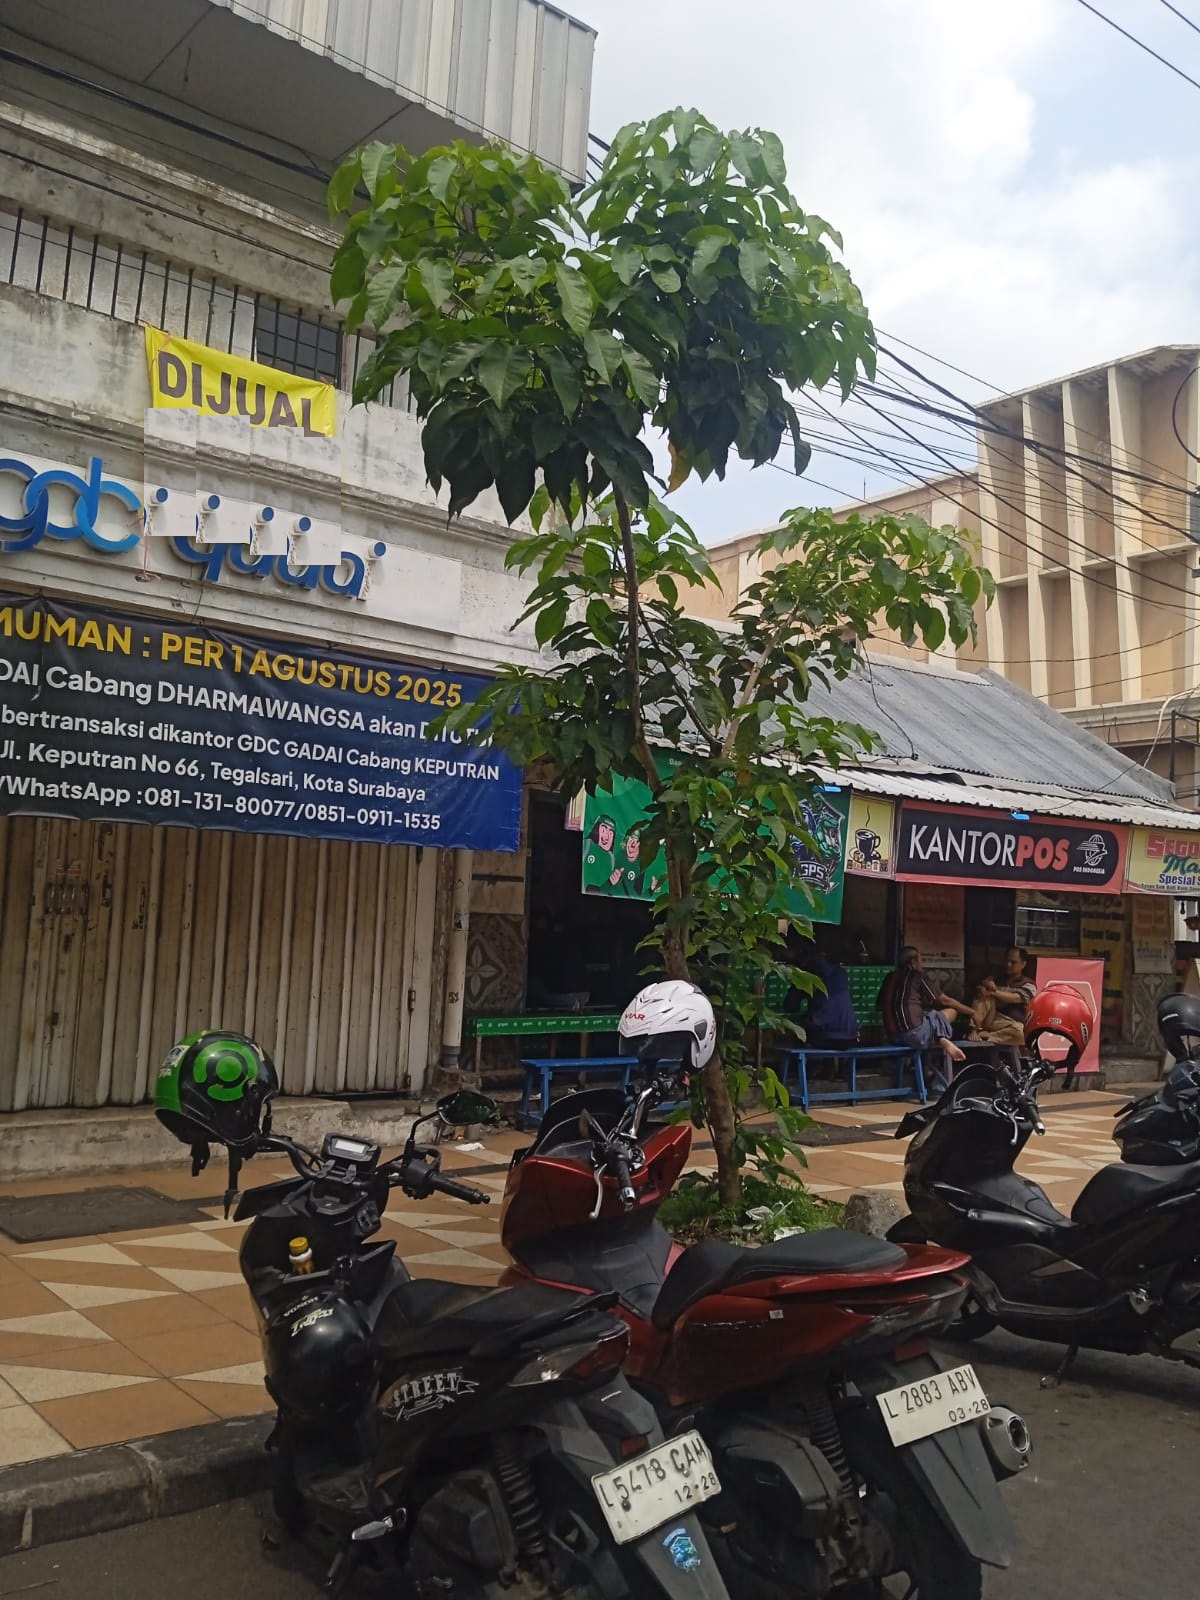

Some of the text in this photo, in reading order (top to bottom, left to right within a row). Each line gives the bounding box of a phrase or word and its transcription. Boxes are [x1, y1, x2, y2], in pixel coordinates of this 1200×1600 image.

[157, 350, 326, 437] DIJUAL
[161, 632, 224, 670] PER
[231, 645, 242, 673] 1
[248, 649, 392, 697] AGUSTUS
[395, 674, 462, 708] 2025
[46, 666, 152, 705] Cabang
[158, 681, 365, 731] DHARMAWANGSA
[369, 715, 415, 738] akan
[2, 704, 500, 780] bertransaksi dikantor GDC GADAI Cabang KEPUTRAN
[29, 742, 136, 770] Keputran
[141, 754, 170, 773] No
[175, 758, 205, 780] 66,
[211, 762, 299, 790] Tegalsari,
[303, 773, 343, 793] Kota
[348, 778, 426, 804] Surabaya
[1159, 873, 1195, 886] Spesial
[393, 1372, 457, 1408] STREET
[883, 1367, 976, 1419] L 2883 ABV
[598, 1484, 614, 1508] L
